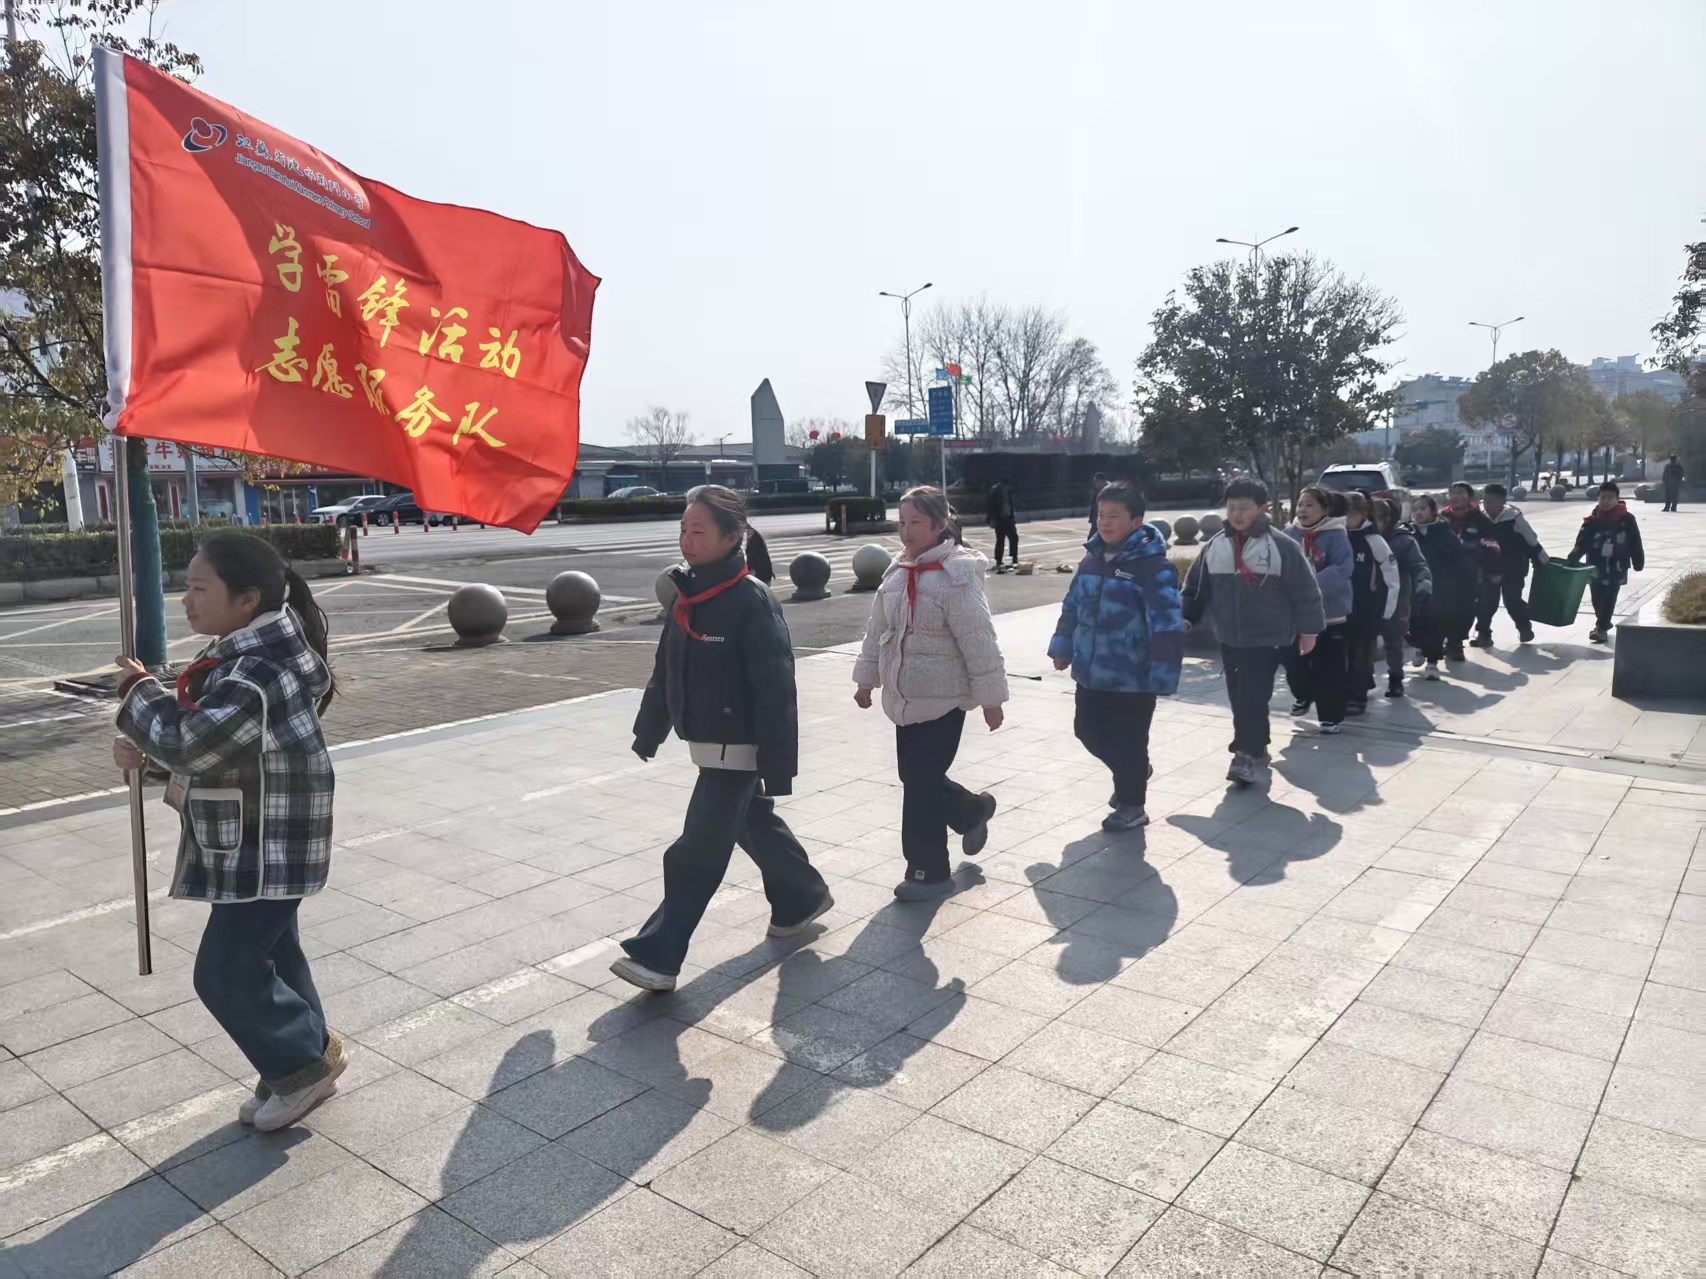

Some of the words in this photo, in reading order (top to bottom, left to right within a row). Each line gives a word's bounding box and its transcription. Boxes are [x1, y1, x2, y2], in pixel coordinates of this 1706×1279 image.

[235, 153, 266, 174] Jiangsu
[322, 196, 348, 219] Primary
[348, 209, 370, 229] School
[269, 224, 521, 378] 学雷锋活动
[255, 317, 506, 447] 志愿服务队
